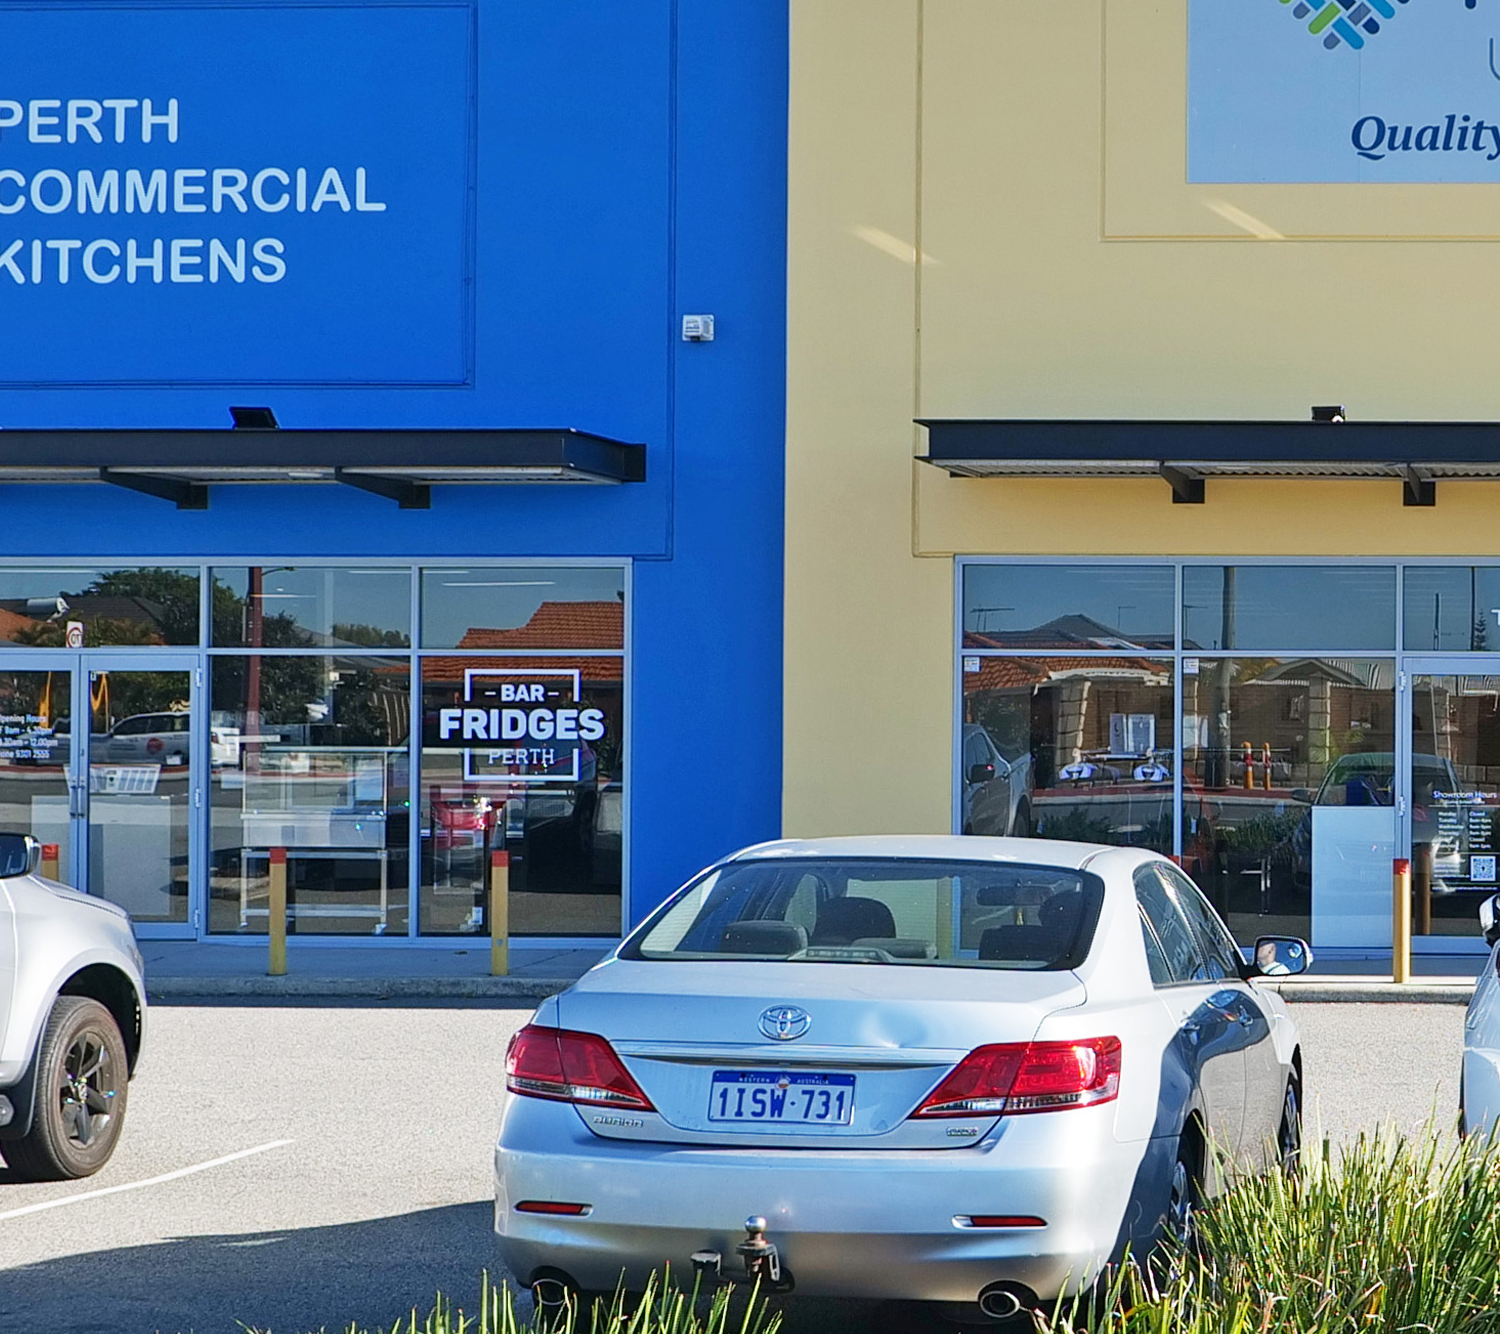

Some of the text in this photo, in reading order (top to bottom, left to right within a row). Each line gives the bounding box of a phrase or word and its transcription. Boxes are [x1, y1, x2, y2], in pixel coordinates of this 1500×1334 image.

[501, 684, 544, 702] BAR
[439, 708, 605, 741] FRIDGES
[488, 748, 555, 764] PERTH
